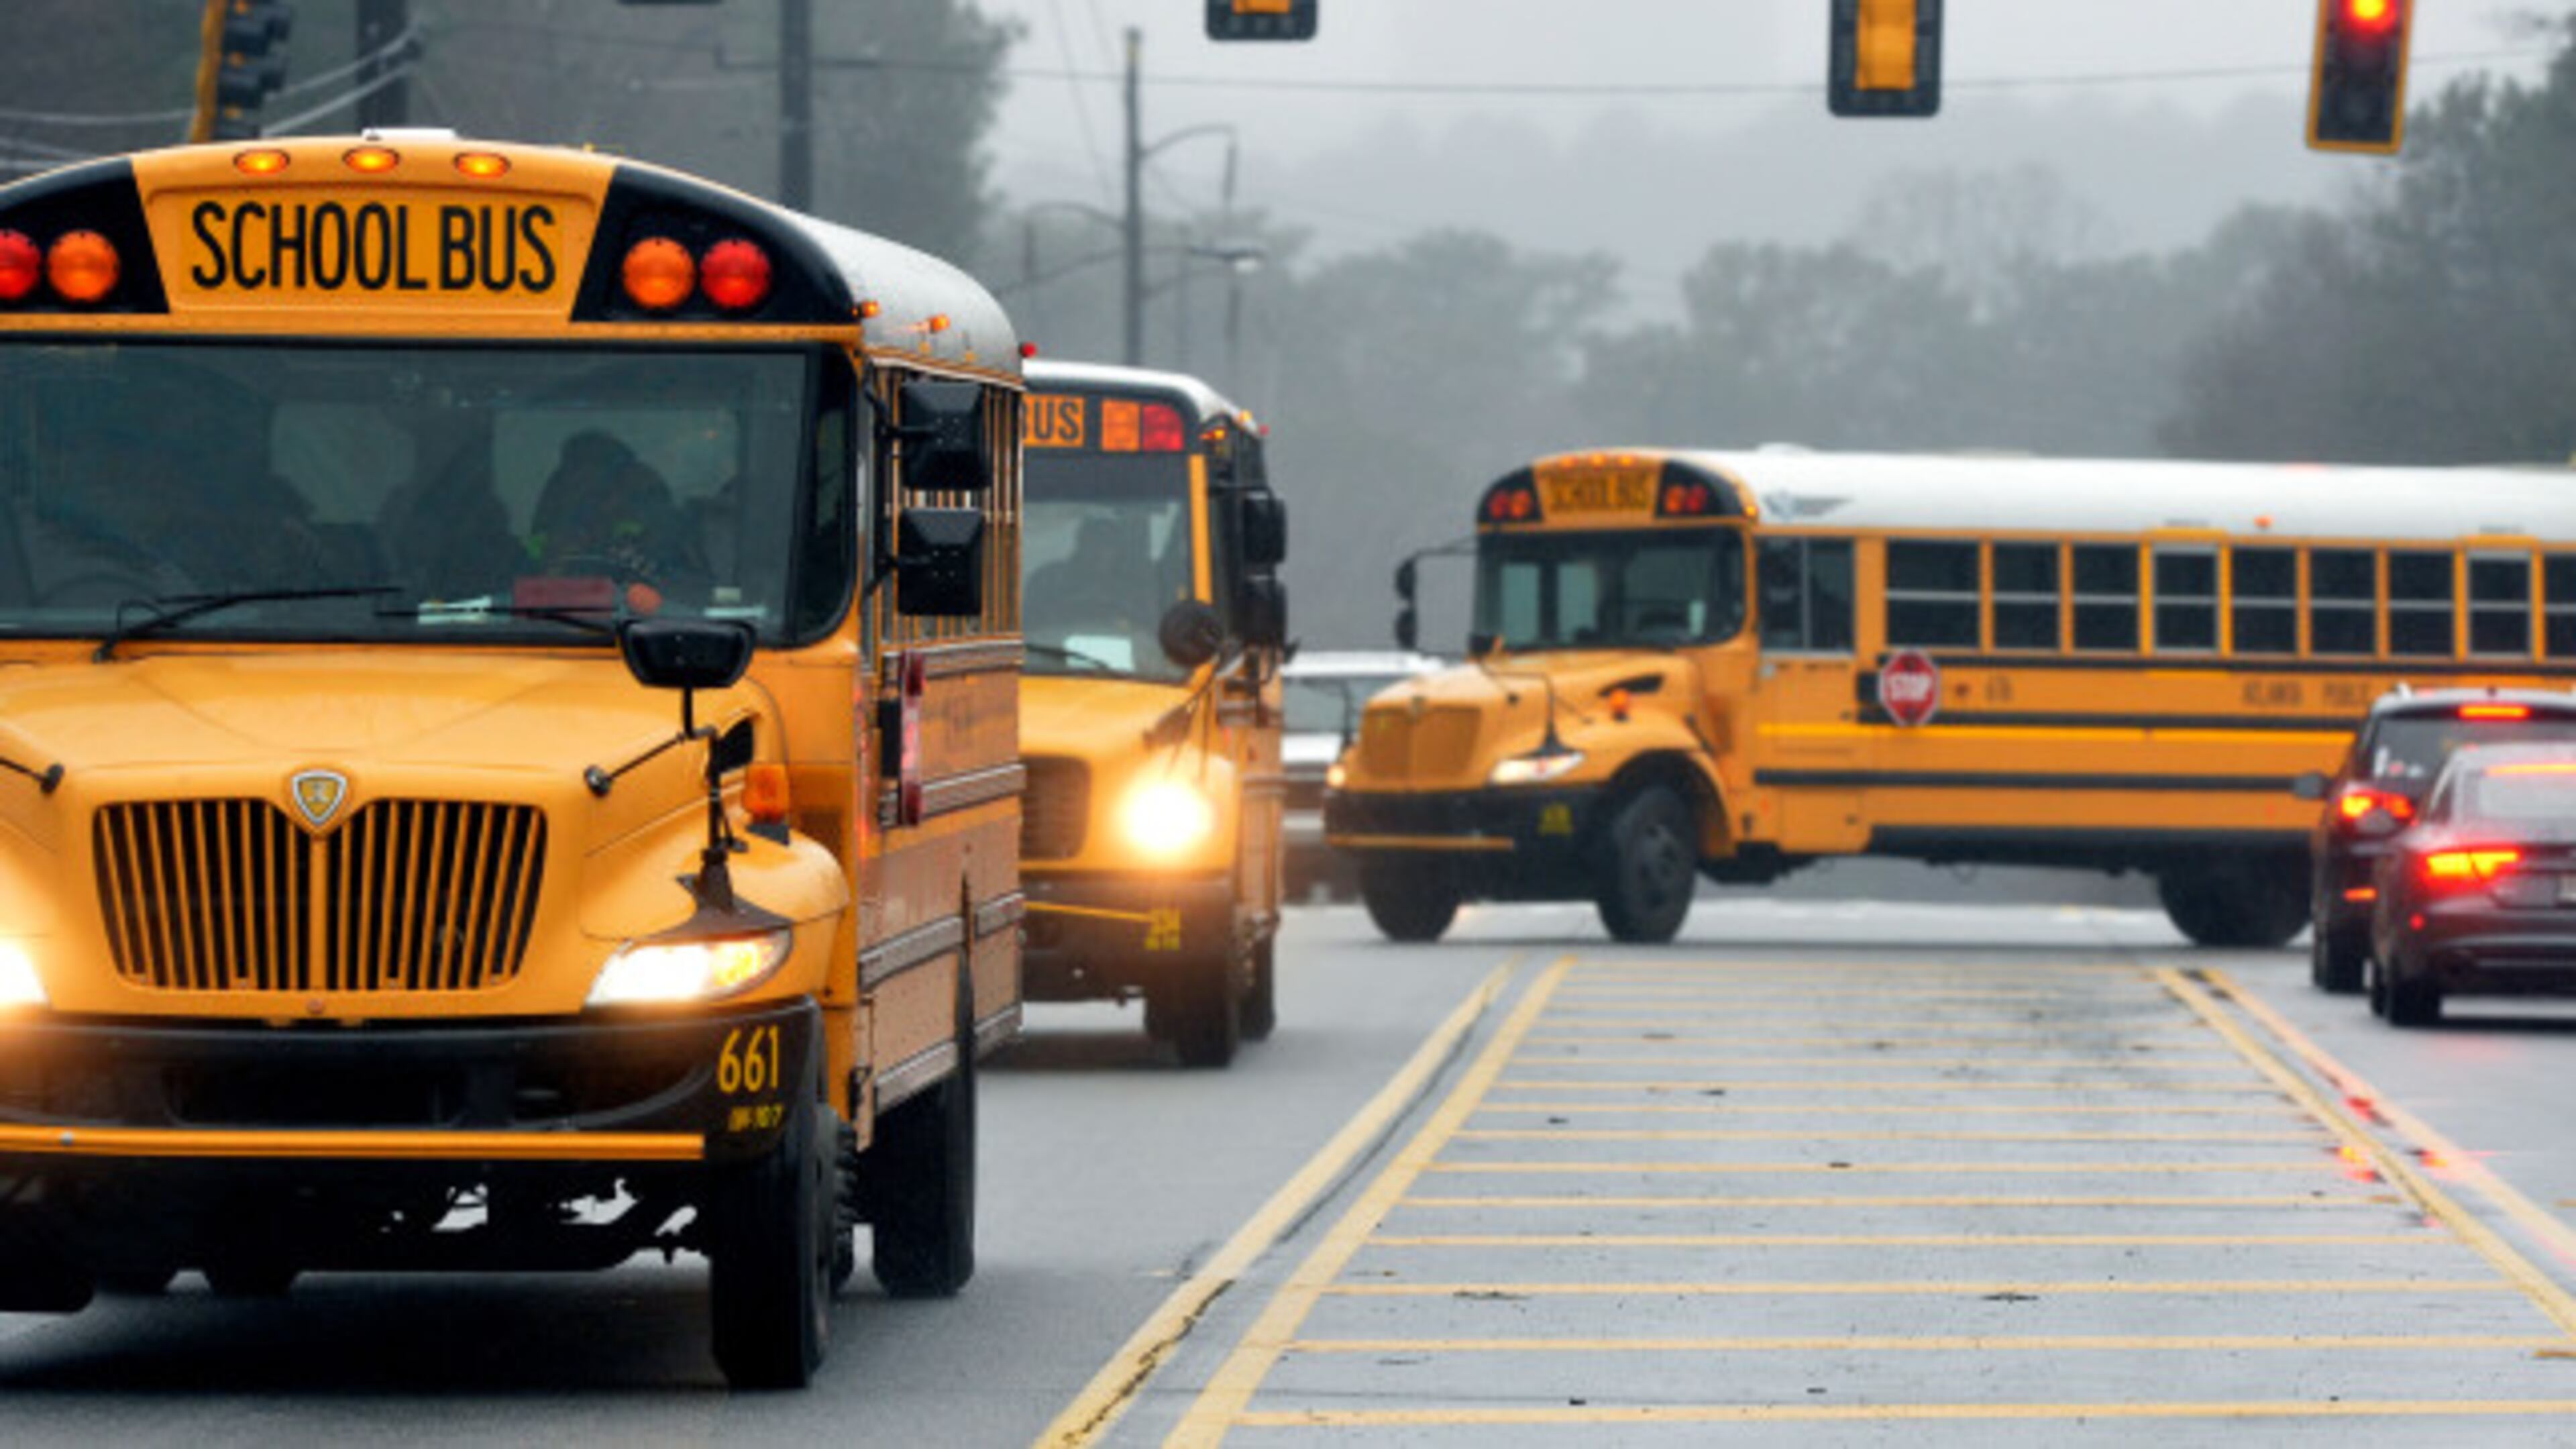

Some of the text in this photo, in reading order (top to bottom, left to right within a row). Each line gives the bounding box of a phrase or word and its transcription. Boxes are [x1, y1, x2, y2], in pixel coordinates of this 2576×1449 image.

[192, 201, 556, 293] SCHOOL BUS
[1022, 400, 1079, 439] US
[1886, 673, 1932, 702] STOP
[718, 1024, 780, 1093] 661
